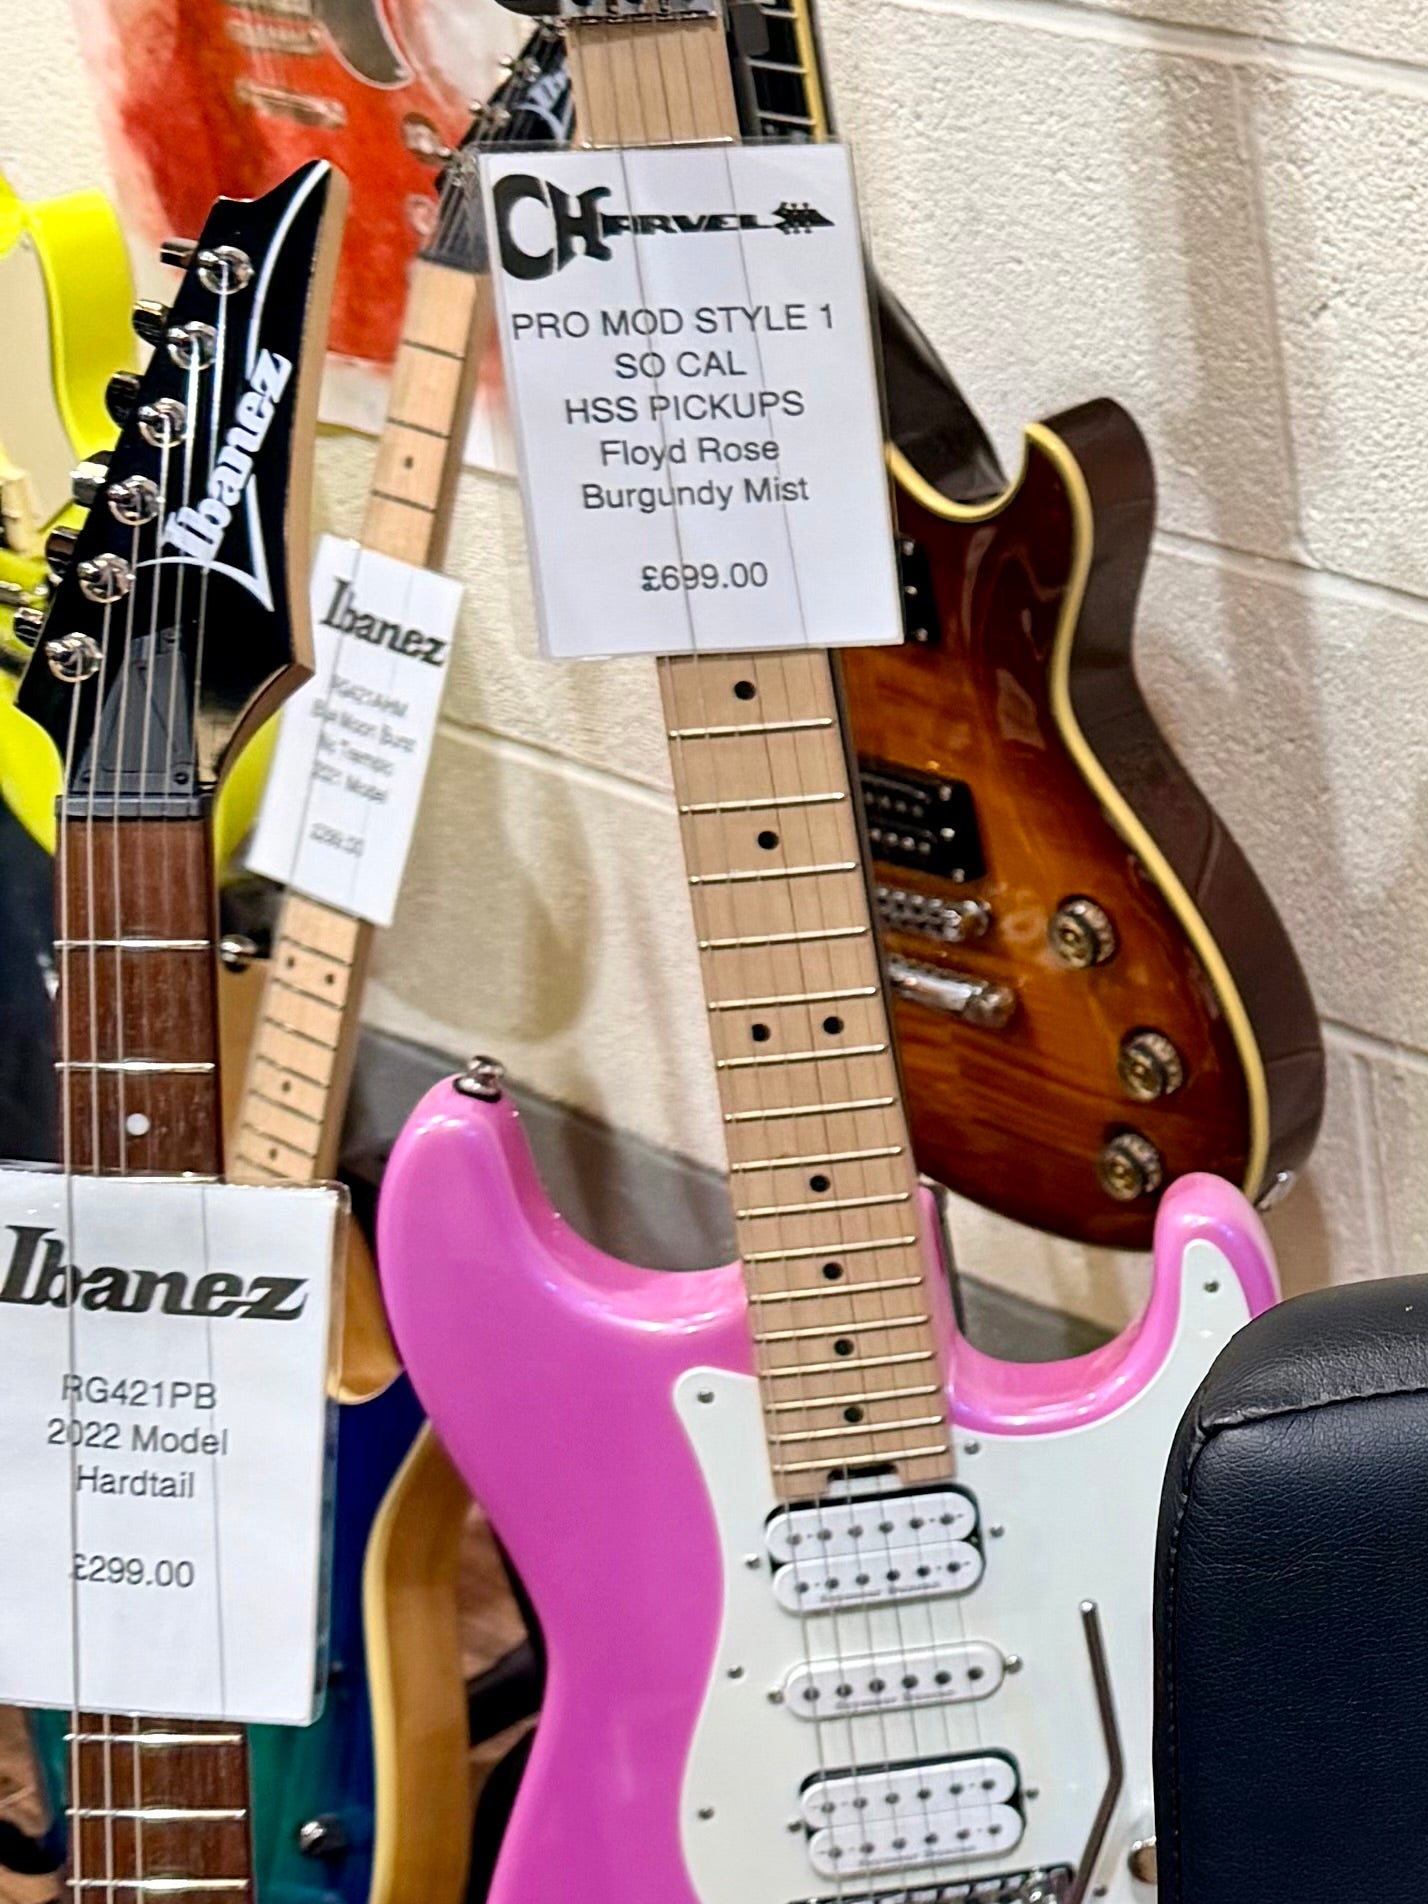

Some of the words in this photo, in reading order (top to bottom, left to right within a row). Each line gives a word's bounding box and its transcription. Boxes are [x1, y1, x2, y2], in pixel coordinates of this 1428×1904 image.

[512, 311, 589, 340] PRO
[601, 308, 683, 337] MOD
[695, 305, 806, 335] STYLE
[820, 303, 834, 330] 1
[615, 351, 665, 381] SO
[676, 349, 747, 378] CAL
[565, 397, 639, 425] HSS
[650, 391, 804, 422] PICKUPS
[163, 348, 293, 562] Ibanez
[600, 438, 686, 472] Floyd
[698, 436, 779, 462] Rose
[582, 483, 733, 514] Burgundy
[744, 477, 810, 503] Mist
[641, 562, 769, 592] £699.00
[319, 575, 448, 667] Ibanez
[0, 1225, 310, 1321] Ibanez
[61, 1374, 217, 1410] RG421PB
[47, 1418, 120, 1450] 2022
[131, 1423, 228, 1455] Model
[76, 1465, 194, 1498] Hardtail
[70, 1553, 194, 1589] £299.00
